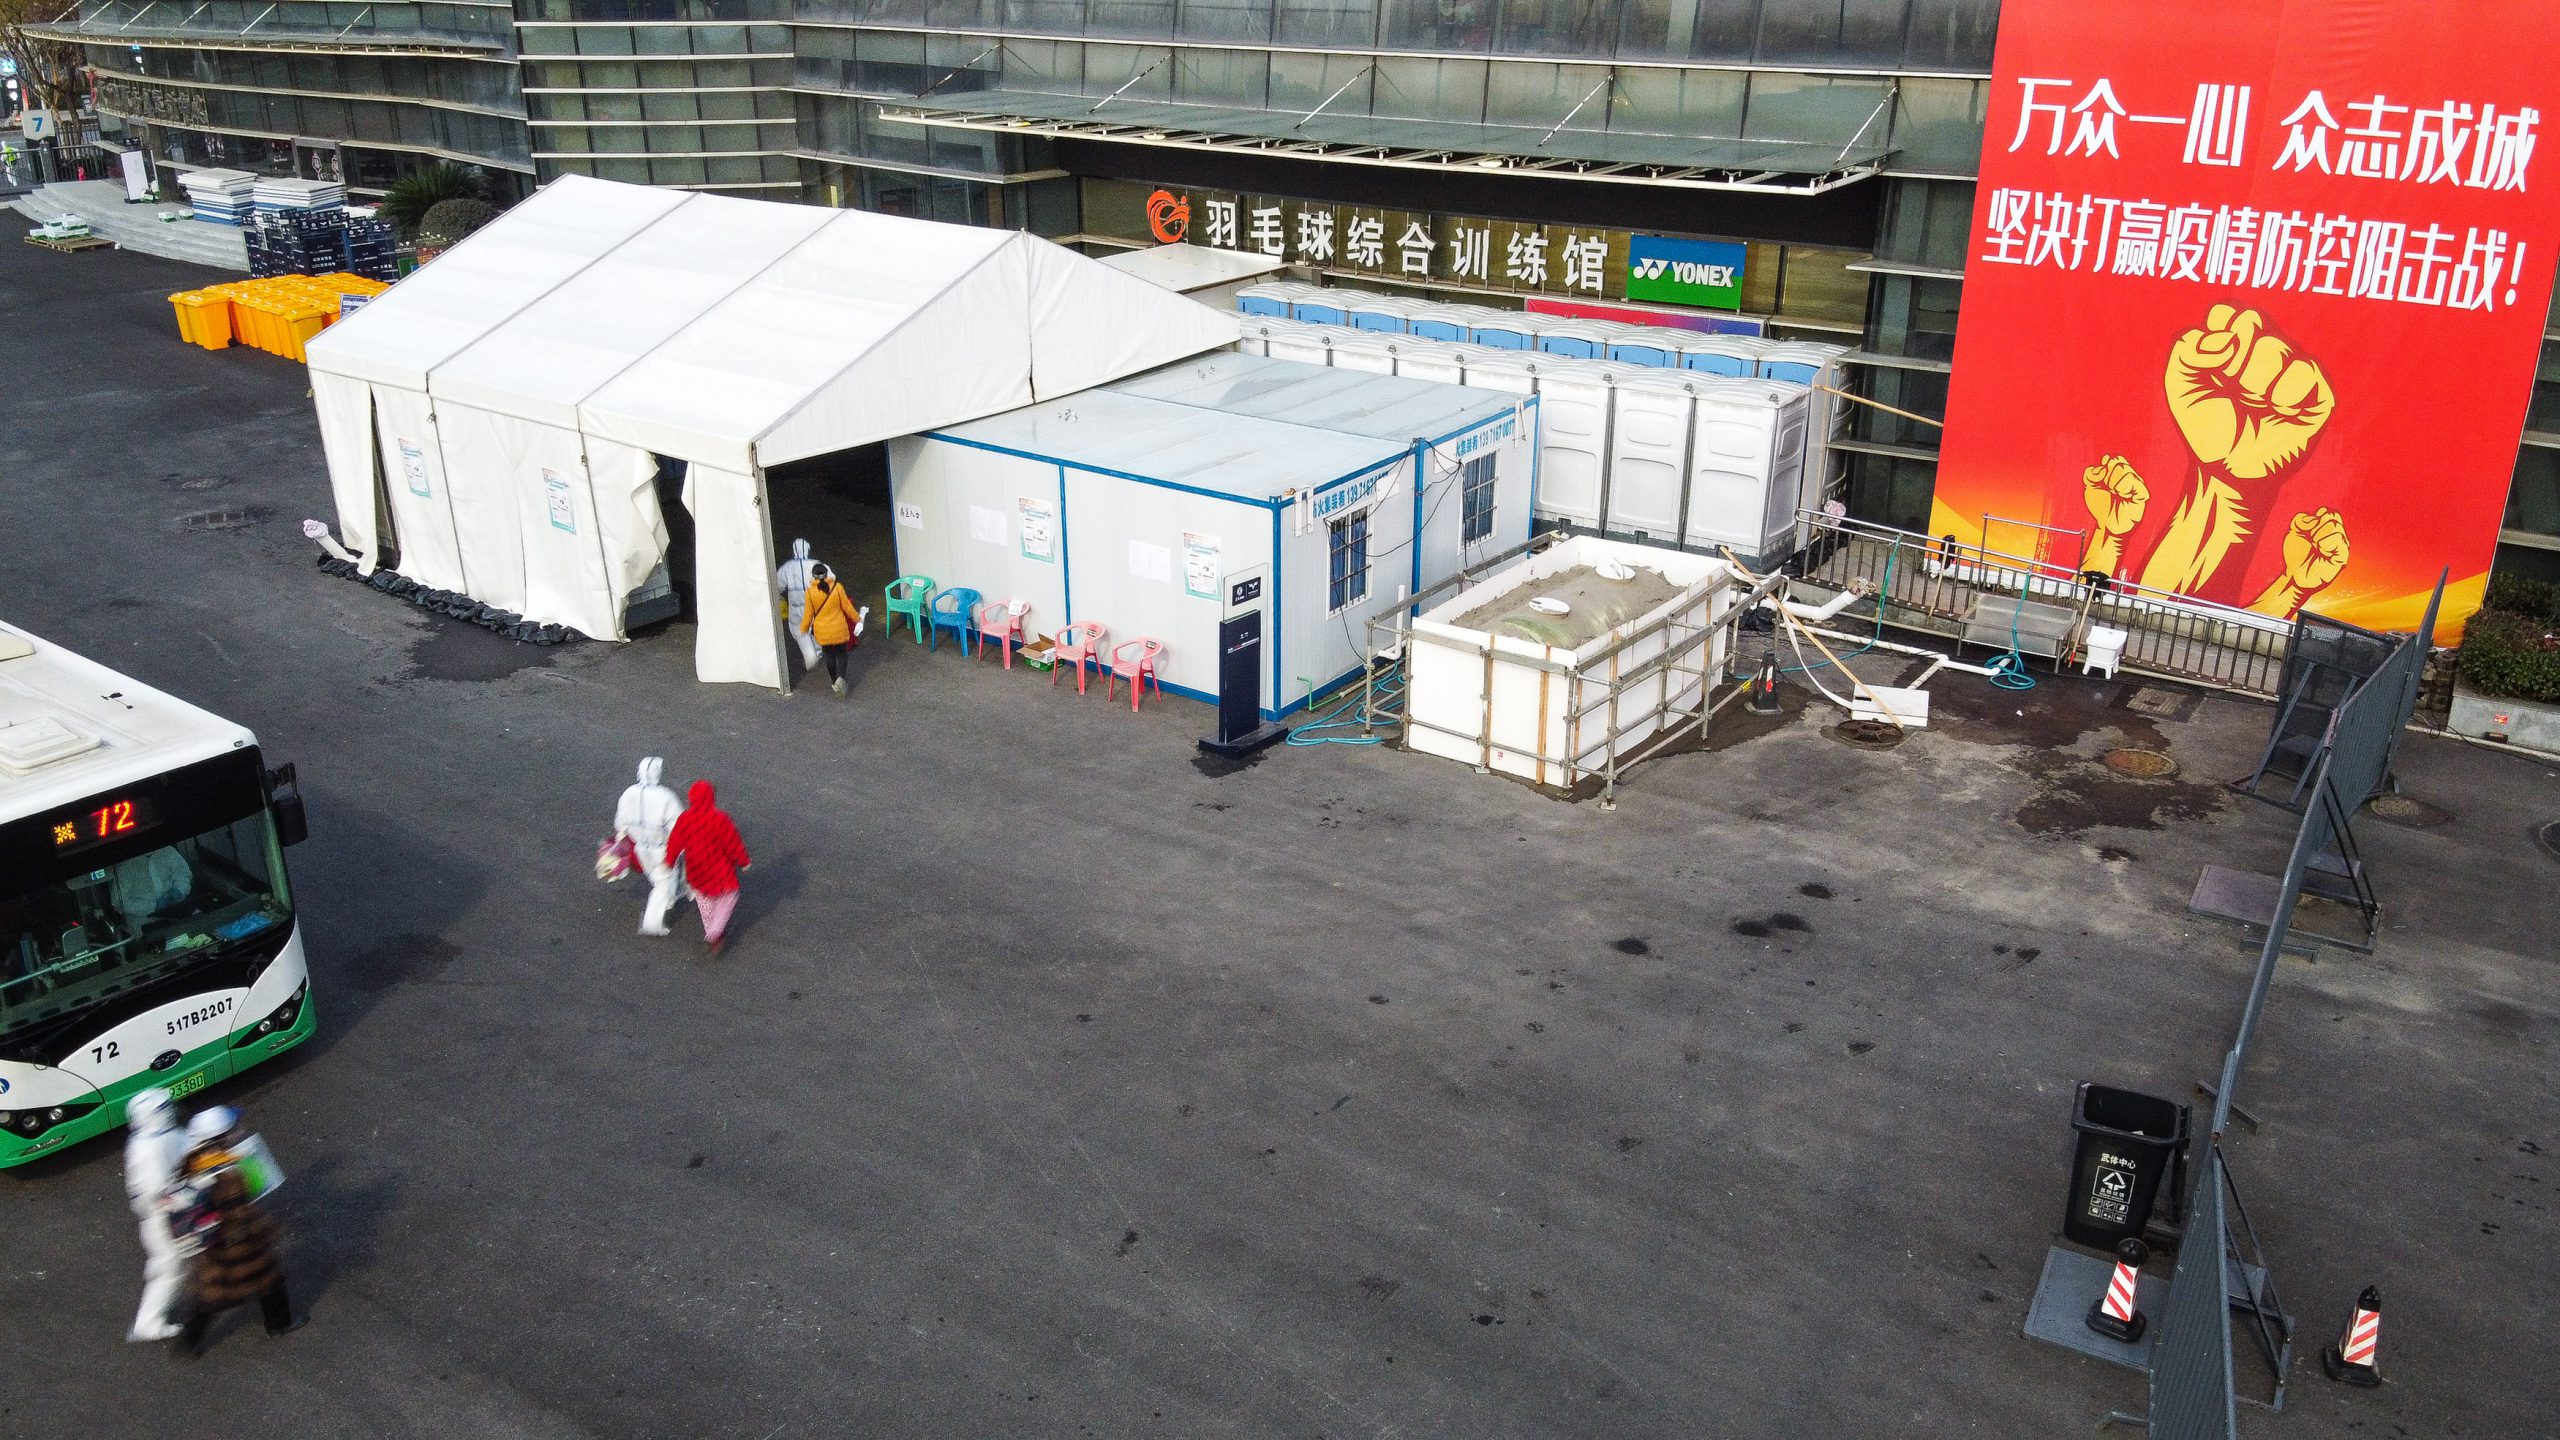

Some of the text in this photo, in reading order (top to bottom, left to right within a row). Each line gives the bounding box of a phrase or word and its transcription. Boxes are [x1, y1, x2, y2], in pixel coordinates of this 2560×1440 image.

[32, 116, 44, 133] 7
[2008, 77, 2540, 193] 万众一心 众志成城
[1205, 199, 1608, 291] 羽毛球综合训练馆
[1982, 187, 2527, 313] 坚决打赢疫情防控阻击战!
[1672, 261, 1735, 288] YONEX
[90, 799, 136, 838] 72
[166, 997, 233, 1036] 517B2207
[91, 1041, 120, 1064] 72
[2100, 1153, 2136, 1170] 武体中心
